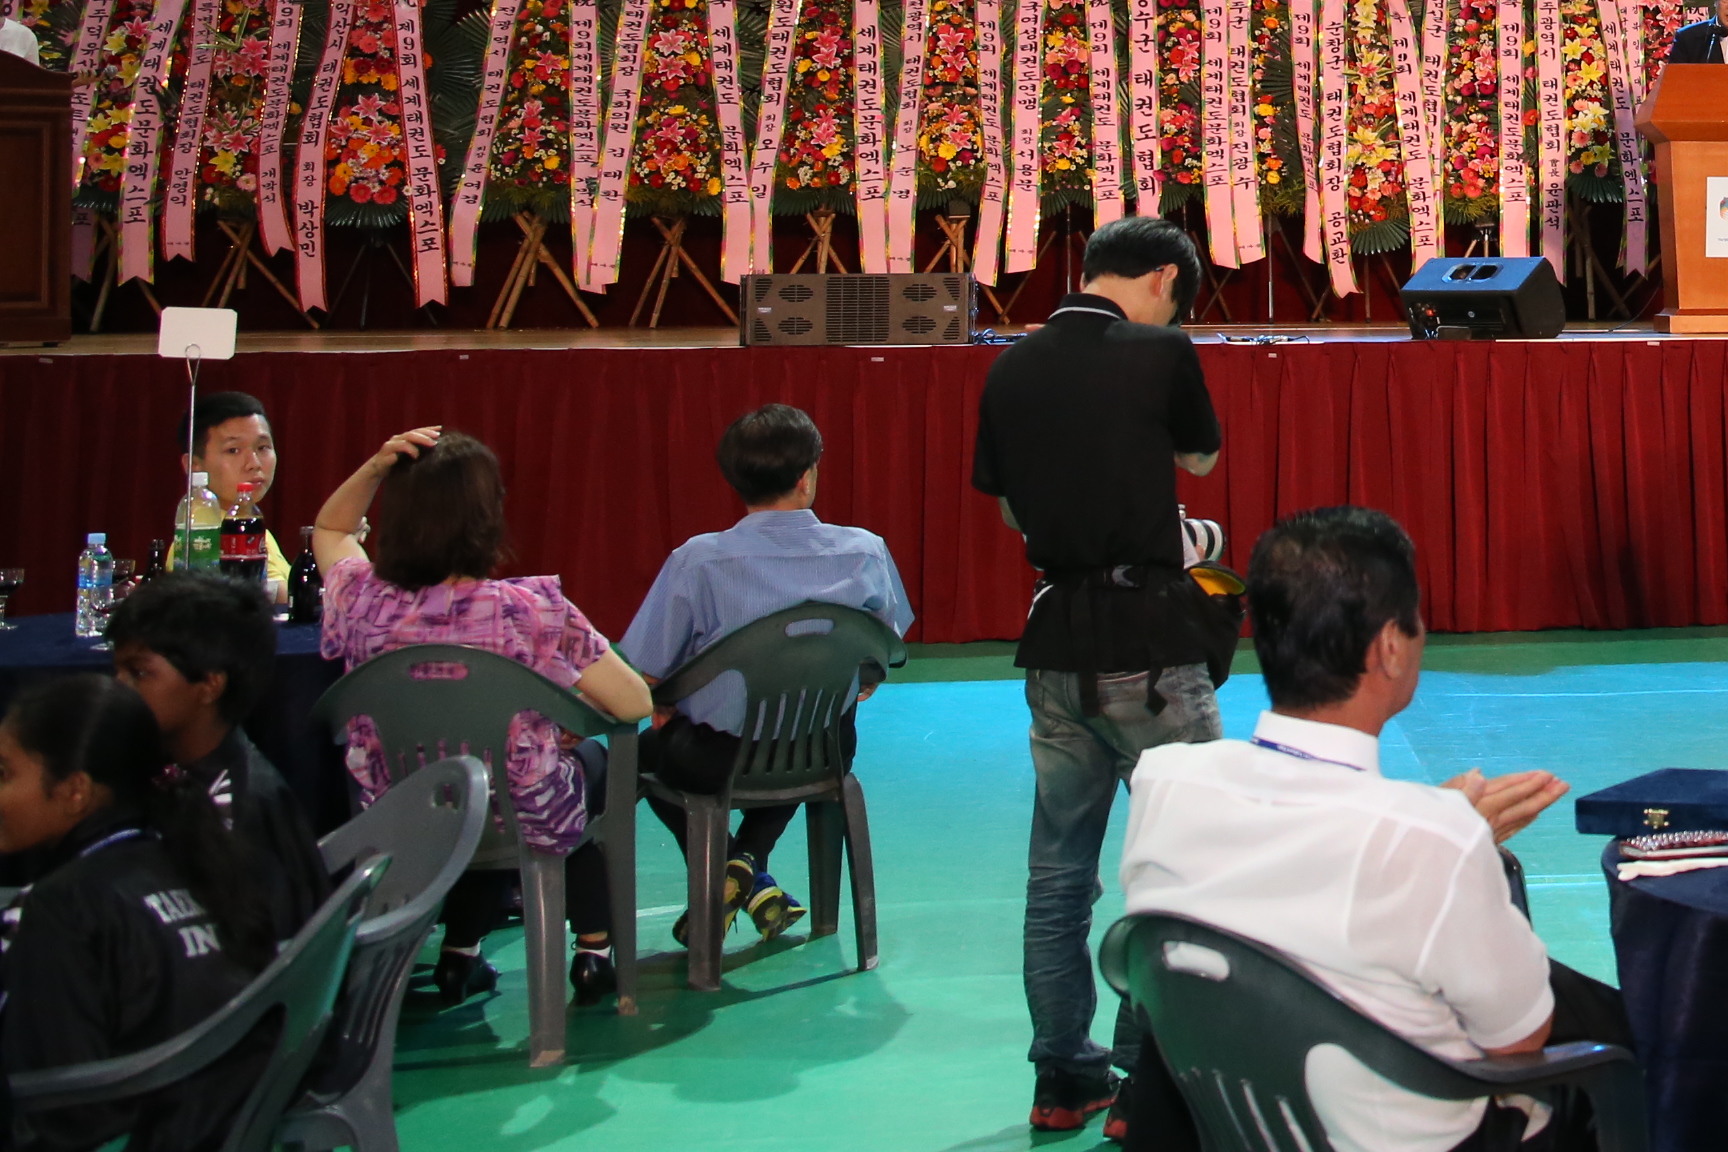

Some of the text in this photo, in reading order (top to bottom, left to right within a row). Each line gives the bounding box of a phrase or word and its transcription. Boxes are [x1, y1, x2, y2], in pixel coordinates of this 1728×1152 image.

[1088, 20, 1109, 55] 제9회
[1203, 6, 1223, 43] 제9회
[1500, 21, 1520, 60] 제9회
[397, 19, 419, 69] 제9회
